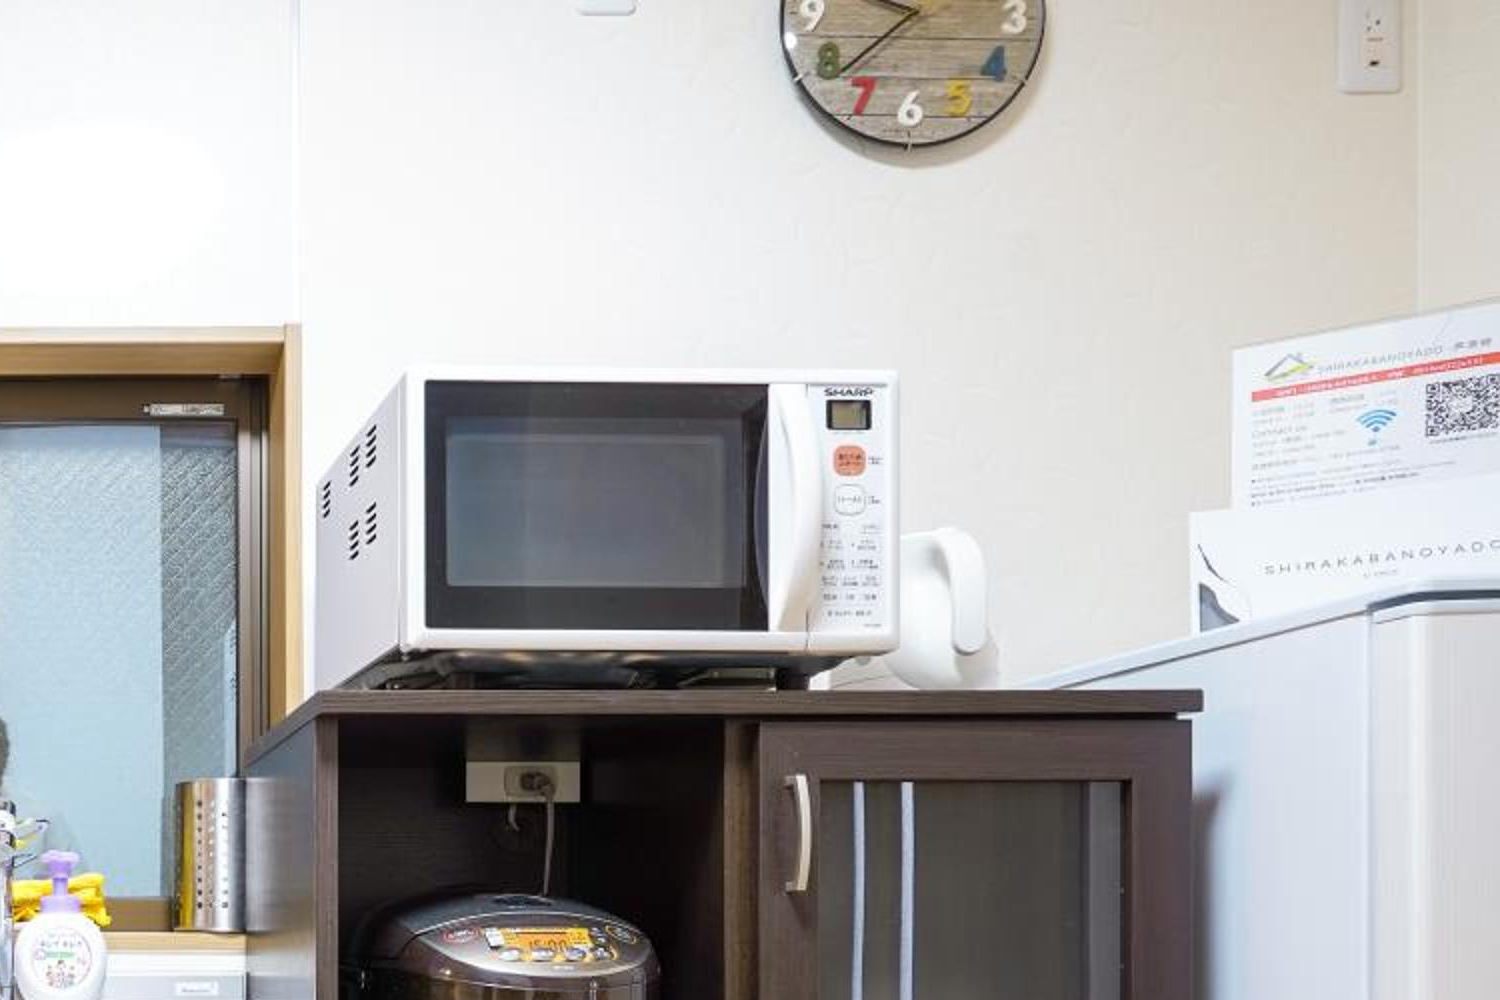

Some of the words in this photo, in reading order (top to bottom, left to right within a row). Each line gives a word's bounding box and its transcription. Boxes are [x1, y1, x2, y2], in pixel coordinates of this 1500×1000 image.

[799, 0, 825, 32] 9
[1001, 0, 1027, 34] 3
[818, 41, 840, 80] 8
[980, 45, 1007, 82] 4
[851, 76, 877, 116] 7
[897, 90, 923, 127] 6
[945, 79, 972, 117] 5
[824, 387, 874, 397] SHARP
